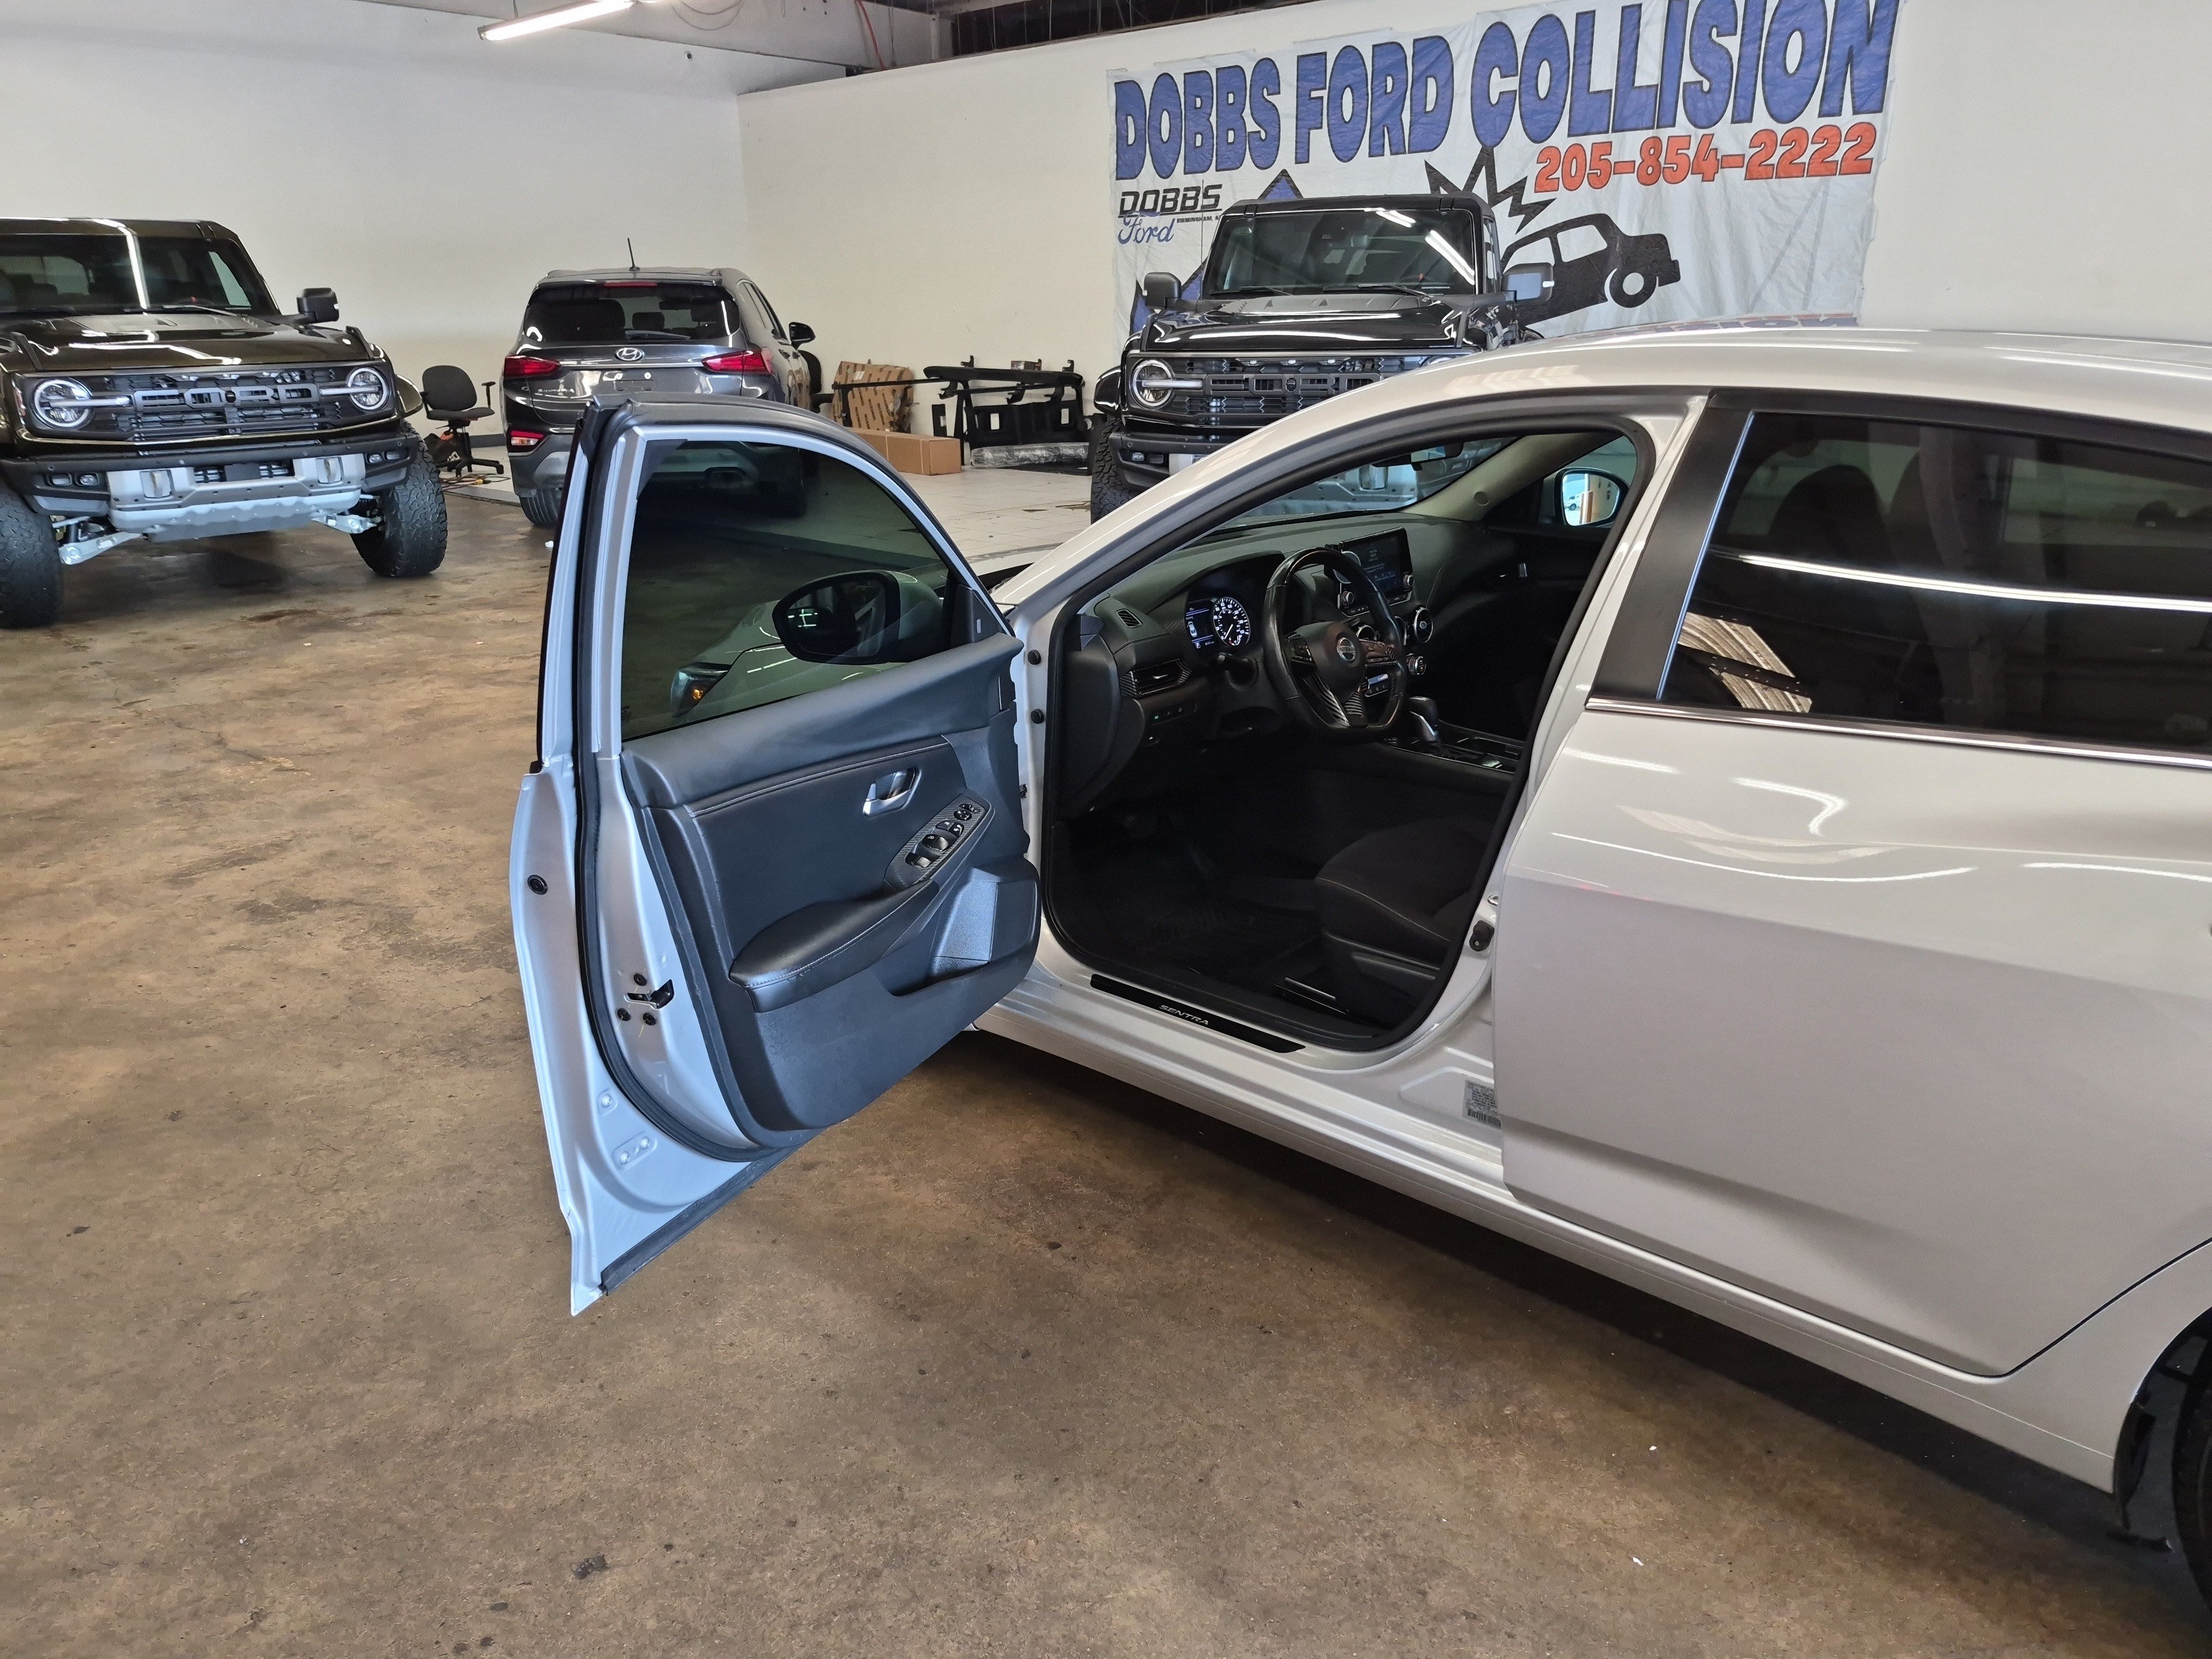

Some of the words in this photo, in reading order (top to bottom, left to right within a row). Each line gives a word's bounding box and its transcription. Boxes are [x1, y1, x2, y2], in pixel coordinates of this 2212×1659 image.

[1115, 57, 1281, 181] DOBBS
[1295, 36, 1454, 164] FORD
[1471, 0, 1899, 147] COLLISION
[1534, 122, 1877, 194] 205-854-2222
[1120, 184, 1223, 215] DOBBS
[1118, 210, 1175, 244] Ford
[133, 383, 319, 411] FORD
[1159, 1005, 1208, 1025] SENTRA
